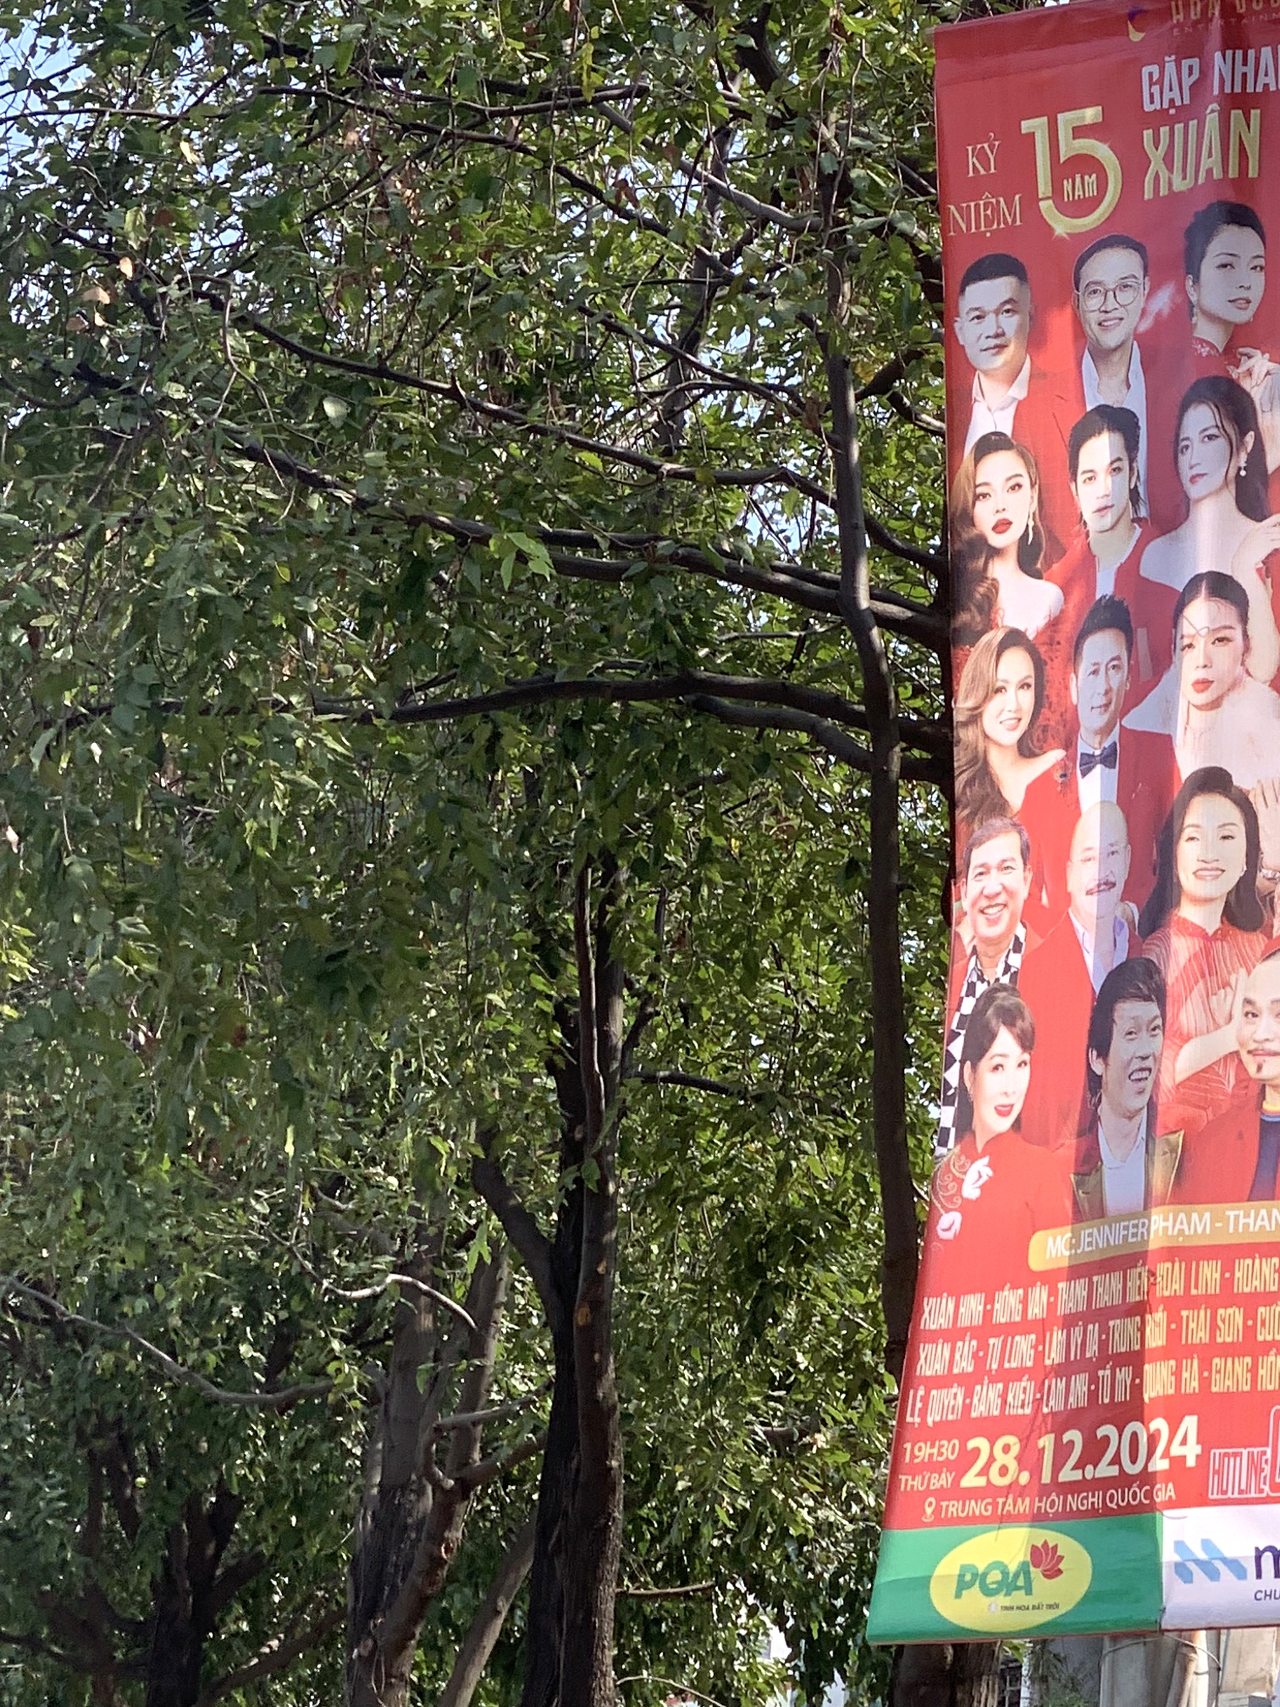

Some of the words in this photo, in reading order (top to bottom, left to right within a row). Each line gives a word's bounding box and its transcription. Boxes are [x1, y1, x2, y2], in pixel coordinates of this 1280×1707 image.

[1142, 57, 1200, 114] GẶP
[965, 132, 1001, 177] KỶ
[1020, 105, 1123, 237] 15
[1143, 103, 1261, 200] XUÂN
[1063, 173, 1098, 202] NĂM
[947, 191, 1023, 237] NIỆM
[1076, 1218, 1148, 1253] JENNIFER
[1149, 1211, 1211, 1243] PHẠM
[920, 1292, 955, 1330] XUÂN
[958, 1292, 986, 1329] HINH
[1027, 1281, 1049, 1320] VÂN
[1057, 1277, 1089, 1316] THANH
[1092, 1270, 1123, 1310] THANH
[1156, 1257, 1186, 1298] HOÀI
[1190, 1259, 1221, 1295] LINH
[1234, 1253, 1280, 1294] HOÀNG
[916, 1338, 951, 1376] XUÂN
[952, 1332, 977, 1374] BẮC
[985, 1334, 1004, 1376] TỰ
[1004, 1333, 1037, 1370] LONG
[1044, 1325, 1067, 1366] LÂM
[1086, 1323, 1100, 1362] DẠ
[1107, 1316, 1141, 1355] TRUNG
[1180, 1304, 1211, 1344] THÁI
[1216, 1306, 1244, 1343] SƠN
[906, 1385, 924, 1428] LỆ
[926, 1382, 966, 1428] QUYÊN
[970, 1376, 1003, 1418] BẰNG
[1042, 1376, 1067, 1414] LAM
[1067, 1373, 1089, 1410] ANH
[1097, 1362, 1113, 1405] TỐ
[1115, 1366, 1133, 1403] MY
[1143, 1359, 1176, 1404] QUANG
[1181, 1354, 1199, 1394] HÀ
[1211, 1356, 1252, 1393] GIANG
[903, 1438, 960, 1464] 19H30
[959, 1414, 1202, 1489] 28.12.2024
[1208, 1446, 1270, 1499] HOTLINE
[898, 1470, 930, 1492] THỨ
[929, 1467, 956, 1491] BẢY
[940, 1497, 992, 1518] TRUNG
[996, 1495, 1030, 1516] TÂM
[1034, 1491, 1063, 1517] HỘI
[1067, 1491, 1103, 1513] NGHỊ
[1106, 1480, 1150, 1509] QUỐC
[1153, 1482, 1177, 1503] GIA
[954, 1560, 1034, 1600] PQA
